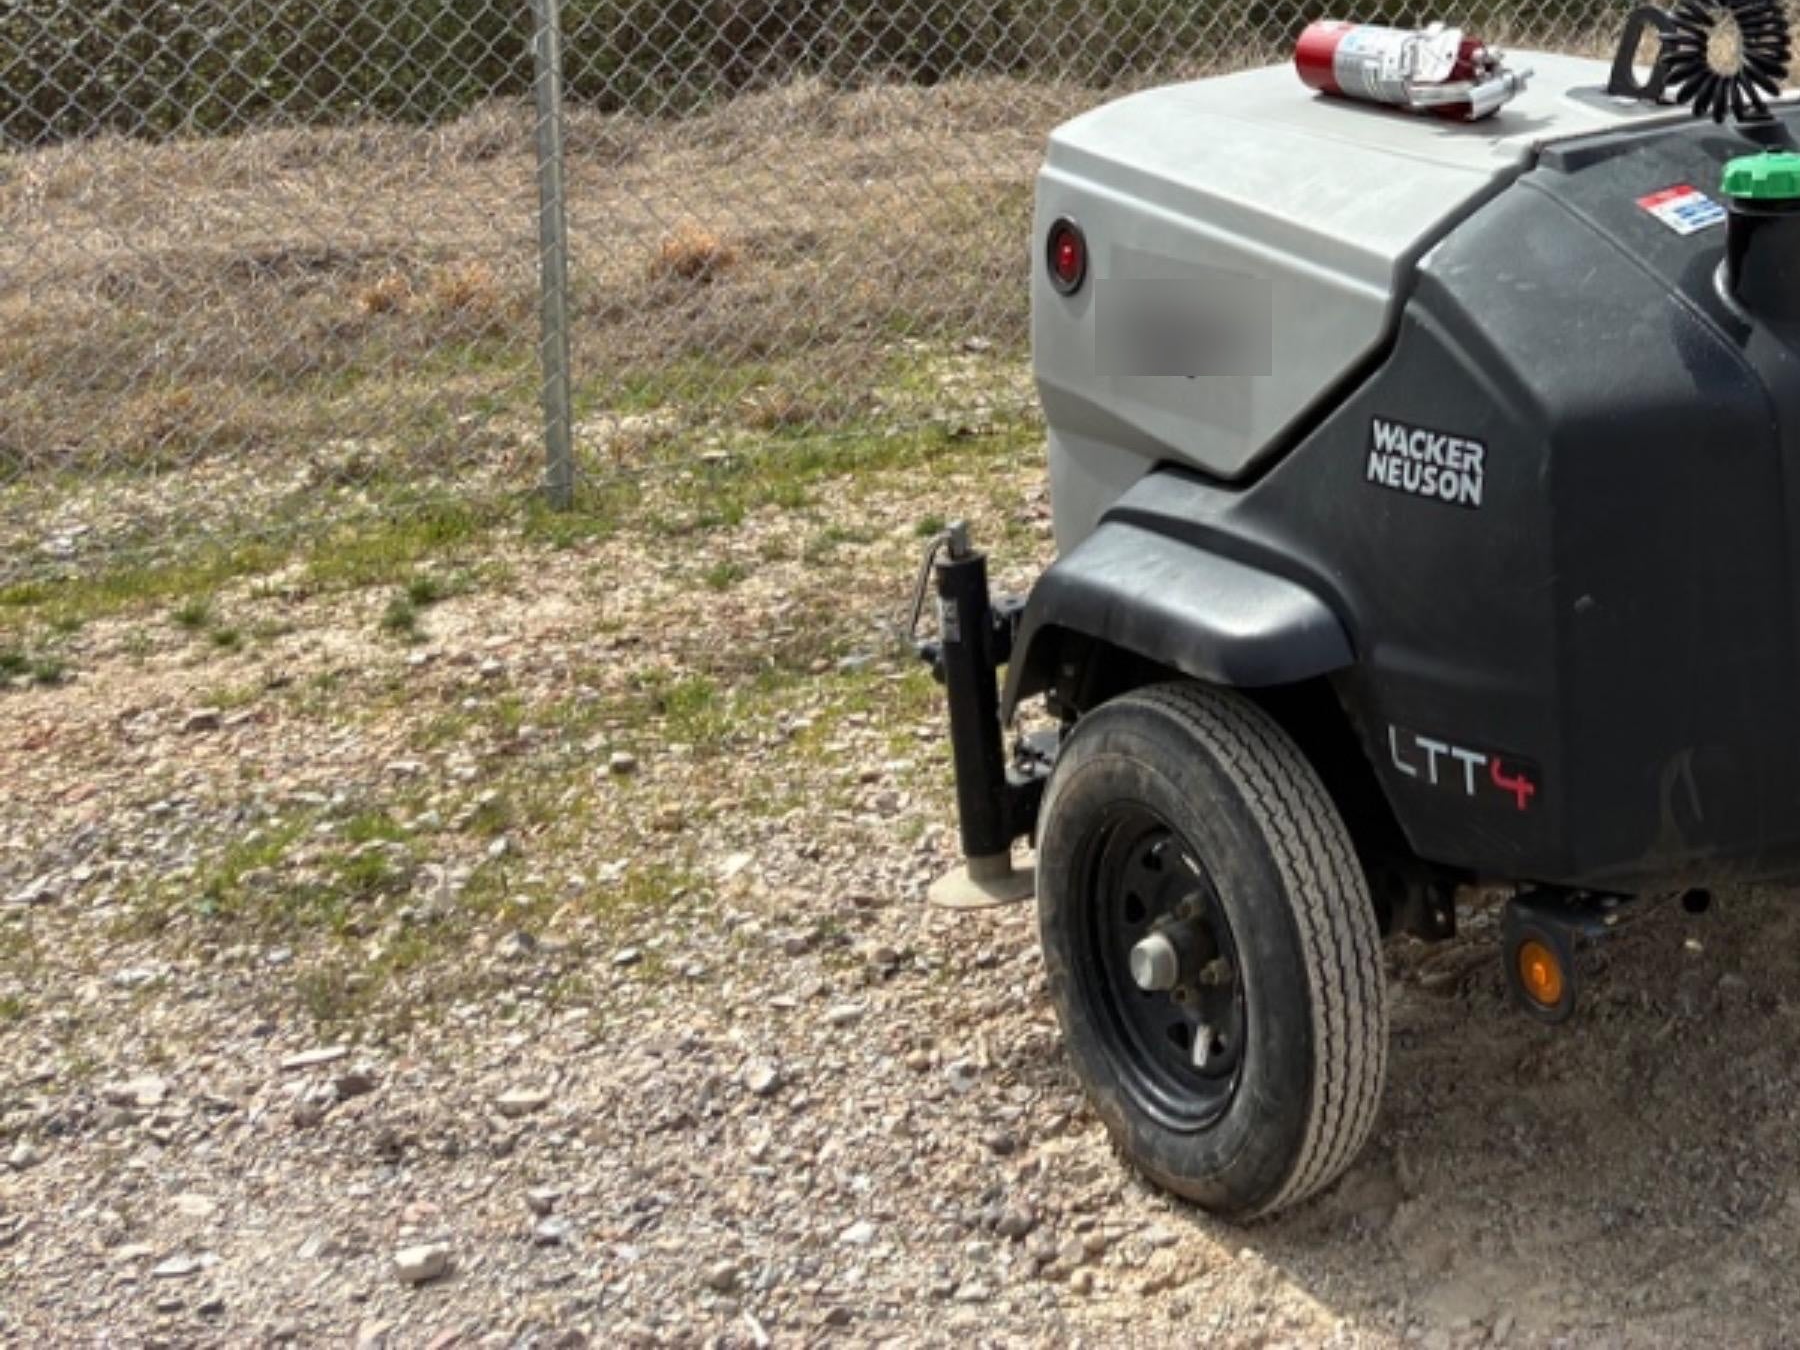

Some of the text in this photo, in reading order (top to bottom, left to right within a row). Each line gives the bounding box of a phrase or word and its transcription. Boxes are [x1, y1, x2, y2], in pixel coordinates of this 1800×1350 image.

[1372, 418, 1484, 475] WACKER
[1366, 450, 1483, 506] NEUSON
[1388, 723, 1535, 811] LTT4
